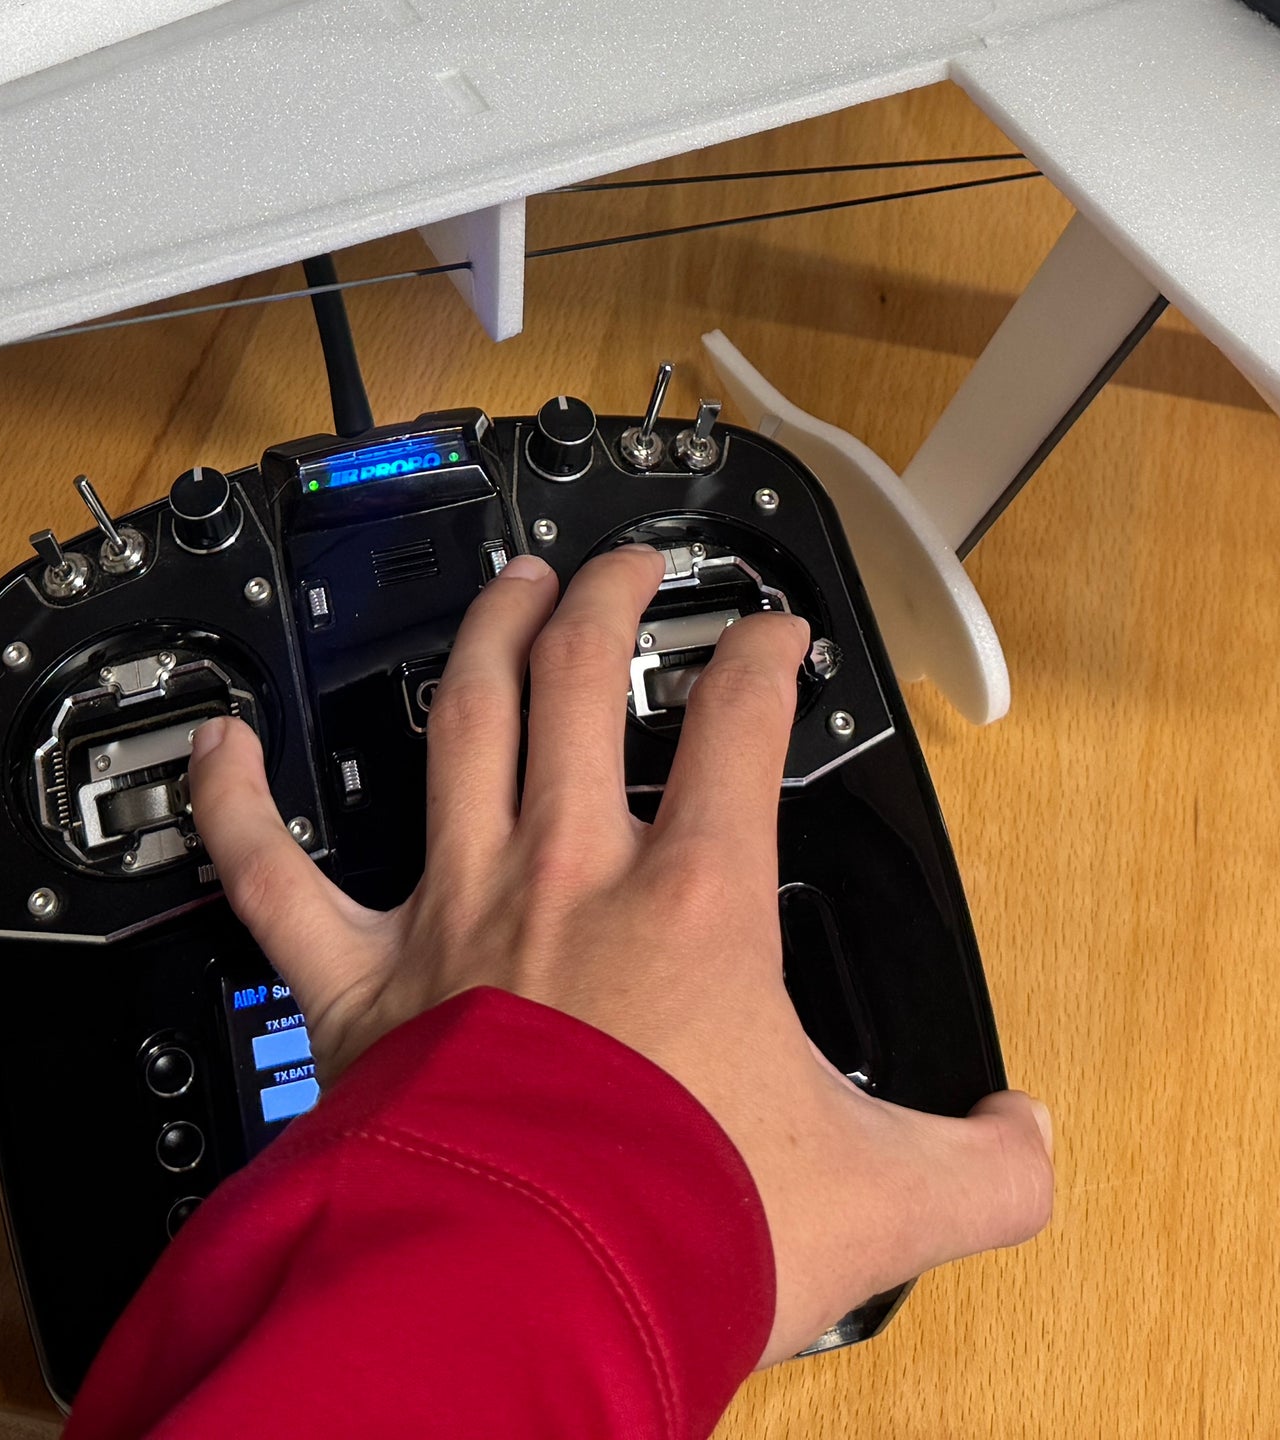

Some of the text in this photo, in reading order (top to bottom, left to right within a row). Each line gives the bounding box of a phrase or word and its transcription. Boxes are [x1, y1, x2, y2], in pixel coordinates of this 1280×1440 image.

[265, 1018, 280, 1031] TX
[274, 1064, 316, 1082] TX BATT
